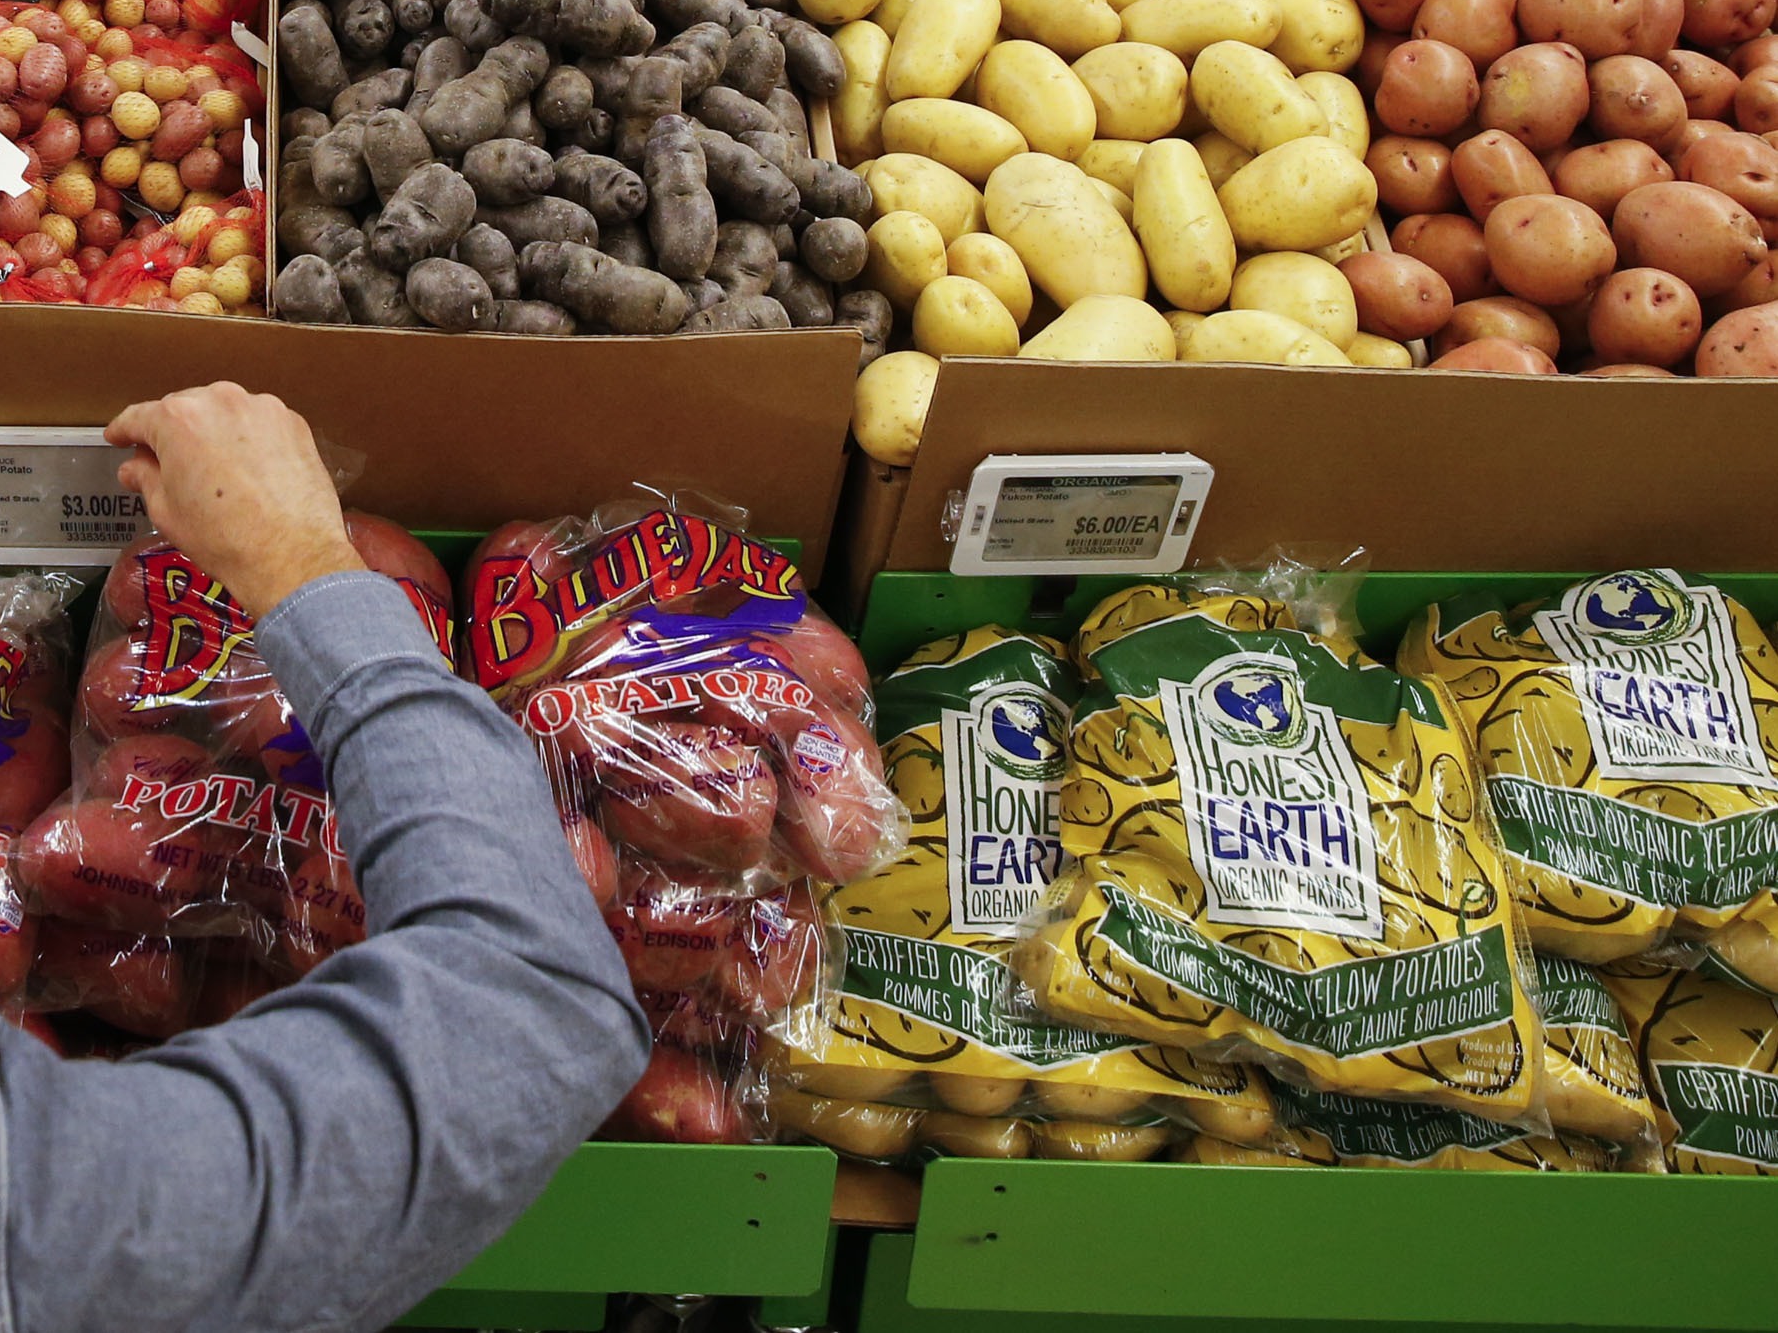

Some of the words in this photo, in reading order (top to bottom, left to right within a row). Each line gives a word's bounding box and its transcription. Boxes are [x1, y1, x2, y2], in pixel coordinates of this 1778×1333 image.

[0, 466, 32, 475] Potato
[1051, 477, 1129, 487] ORGANIC
[62, 494, 148, 518] $3.00/EA
[1001, 493, 1033, 501] Yukon
[1036, 493, 1070, 501] Potato
[67, 533, 133, 541] 3338351010
[1074, 516, 1159, 535] $6.00/EA
[1592, 670, 1737, 745] EARTH
[1205, 724, 1339, 803] HONEST
[1205, 796, 1350, 868] EARTH
[1490, 776, 1598, 839] CERTIFIED
[1604, 807, 1695, 868] ORGANIC
[153, 844, 194, 866] NET
[1216, 867, 1288, 902] ORGANIC
[1297, 871, 1358, 909] FARMS
[1622, 861, 1643, 897] DE
[1303, 960, 1383, 1020] YELLOW
[1391, 936, 1487, 1001] POTATOES
[883, 976, 953, 1023] POMMES
[1223, 974, 1241, 1005] DE
[1248, 993, 1295, 1035] TERRE
[1354, 1002, 1408, 1047] JAUNE
[1413, 981, 1501, 1032] BIOLOGIQUE
[1460, 1039, 1494, 1053] Produce
[1496, 1037, 1505, 1053] of
[1462, 1054, 1495, 1066] Produit
[1466, 1070, 1485, 1084] NET
[1490, 1072, 1505, 1085] WT
